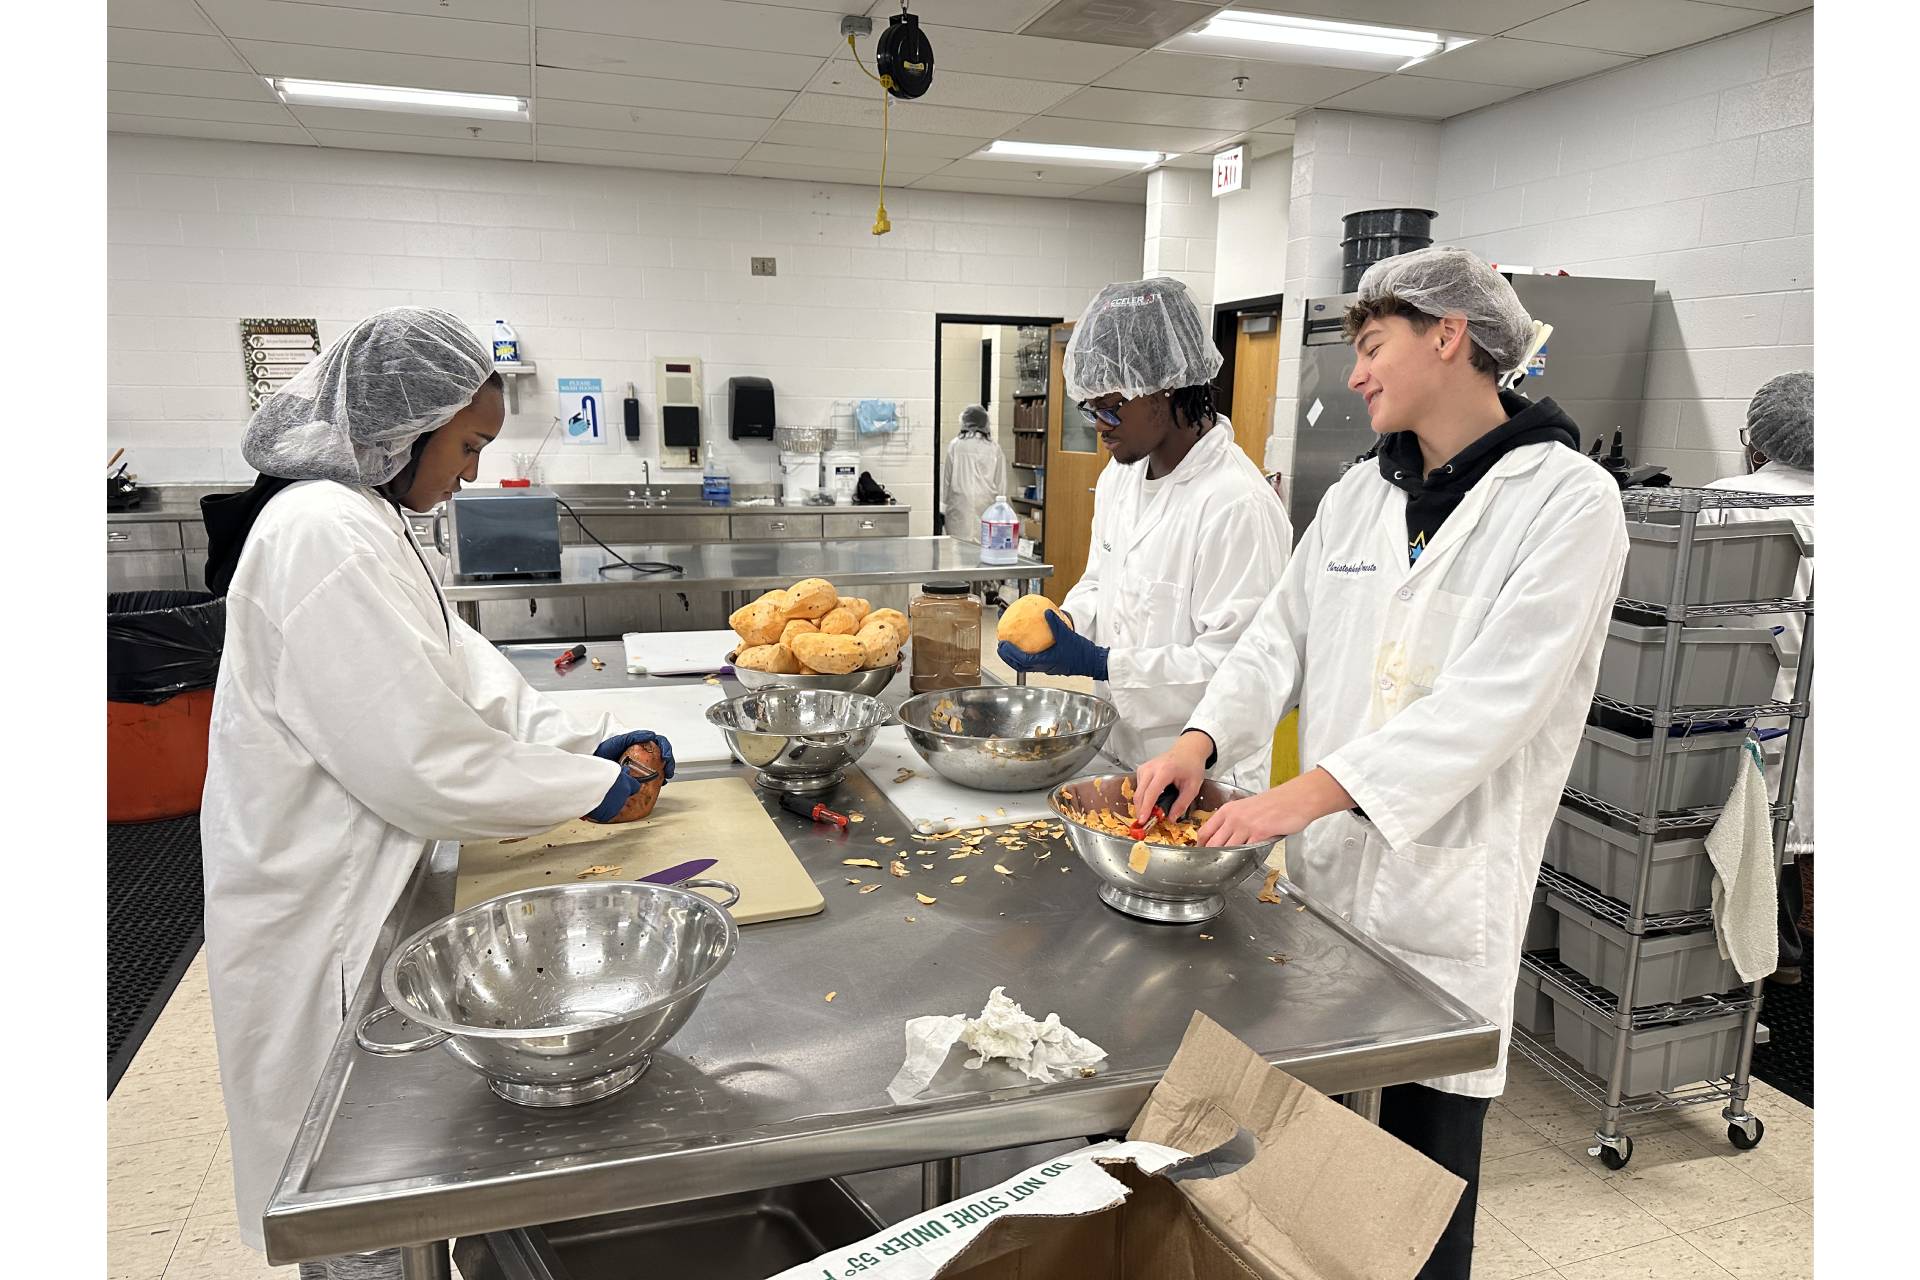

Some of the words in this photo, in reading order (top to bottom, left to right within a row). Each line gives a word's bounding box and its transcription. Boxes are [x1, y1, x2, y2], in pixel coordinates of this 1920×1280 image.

[1217, 154, 1239, 188] EXIT
[1041, 1162, 1073, 1177] DO
[1005, 1177, 1047, 1202] NOT
[943, 1196, 1009, 1229] STORE
[875, 1220, 951, 1256] UNDER
